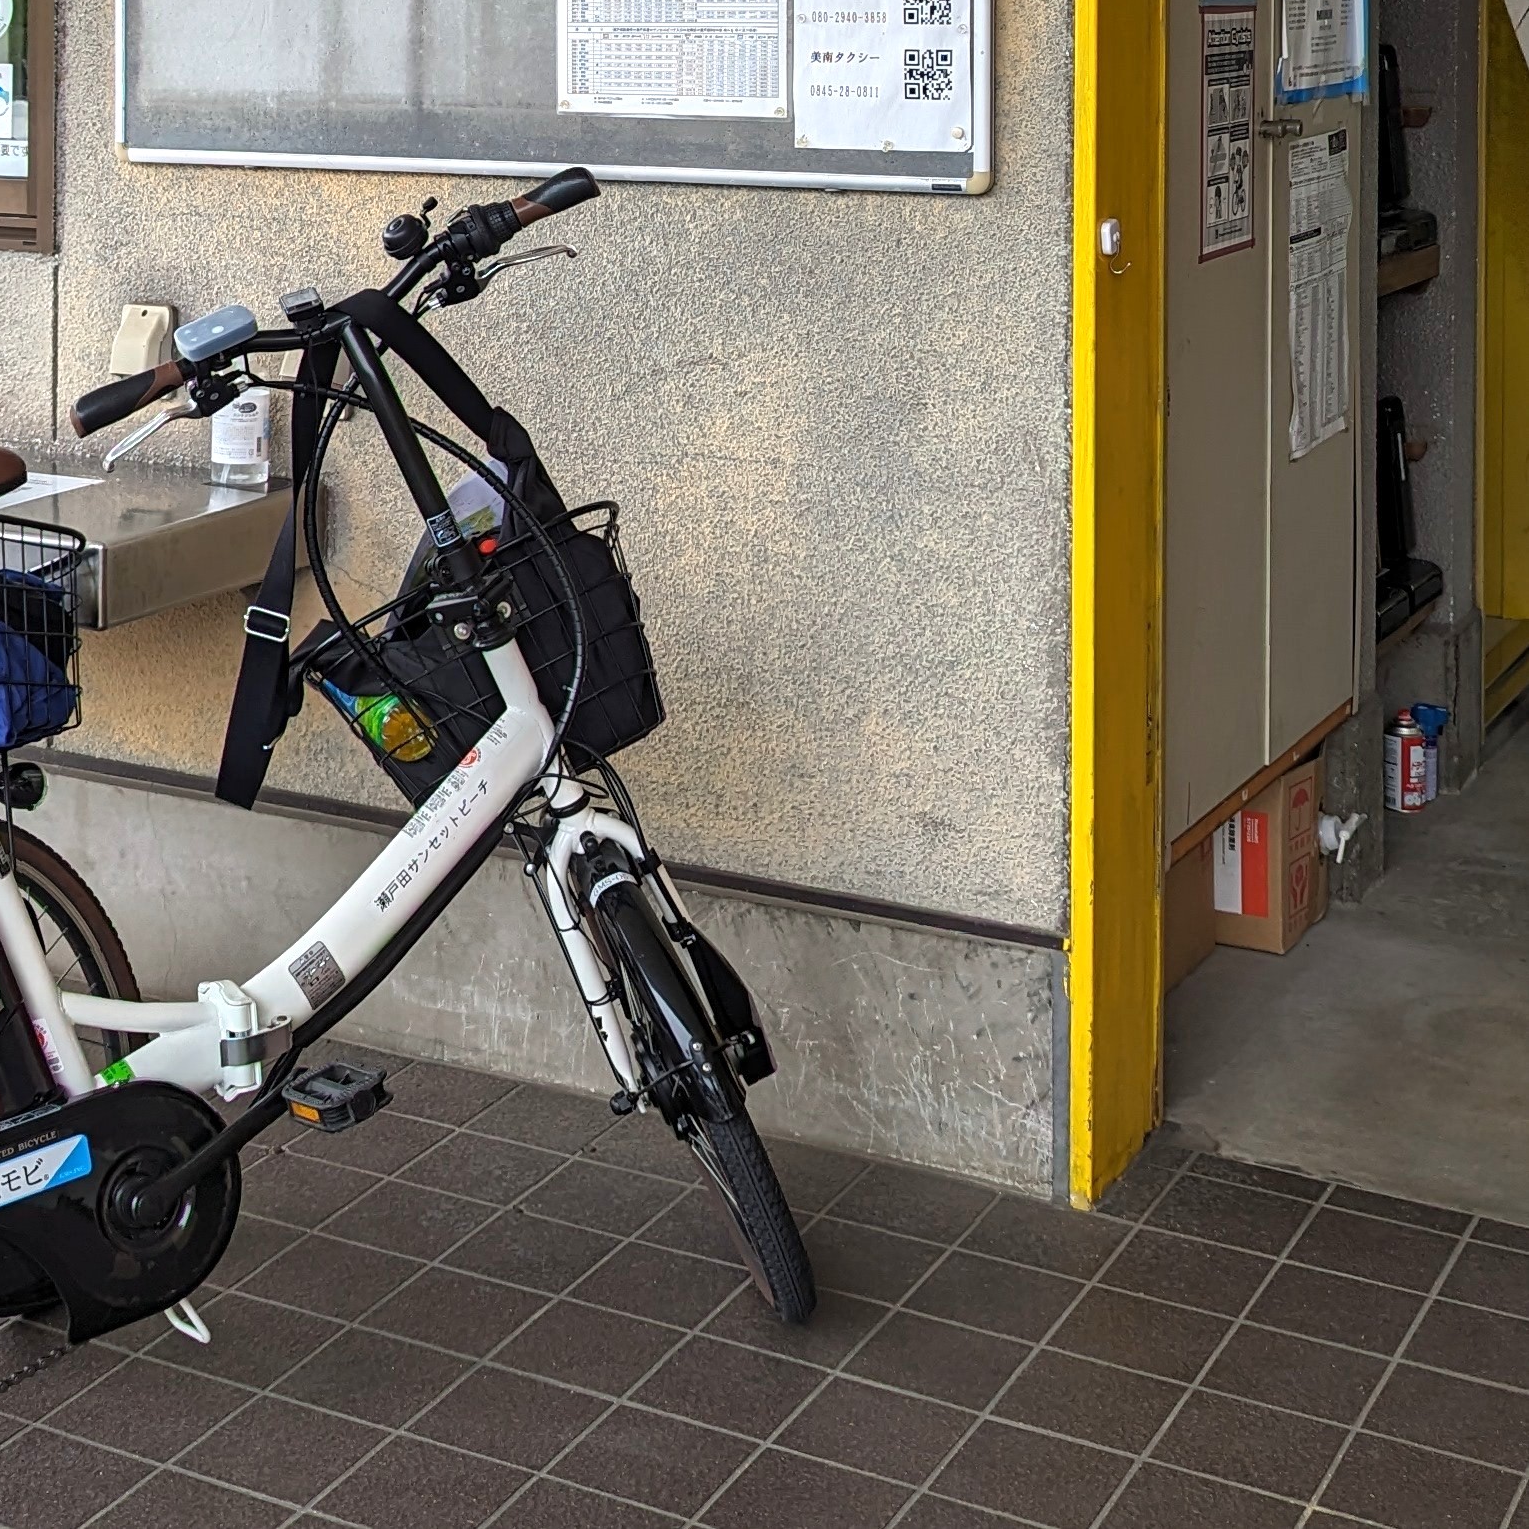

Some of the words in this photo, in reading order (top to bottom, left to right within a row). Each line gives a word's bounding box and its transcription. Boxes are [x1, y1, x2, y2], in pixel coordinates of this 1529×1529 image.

[812, 11, 887, 23] 080-2940-3858
[811, 51, 880, 63] 美南タクシー
[810, 85, 879, 98] 0845-28-0811
[374, 778, 489, 912] 瀬戸田サンセットビーチ
[18, 1130, 57, 1152] BICYCLE
